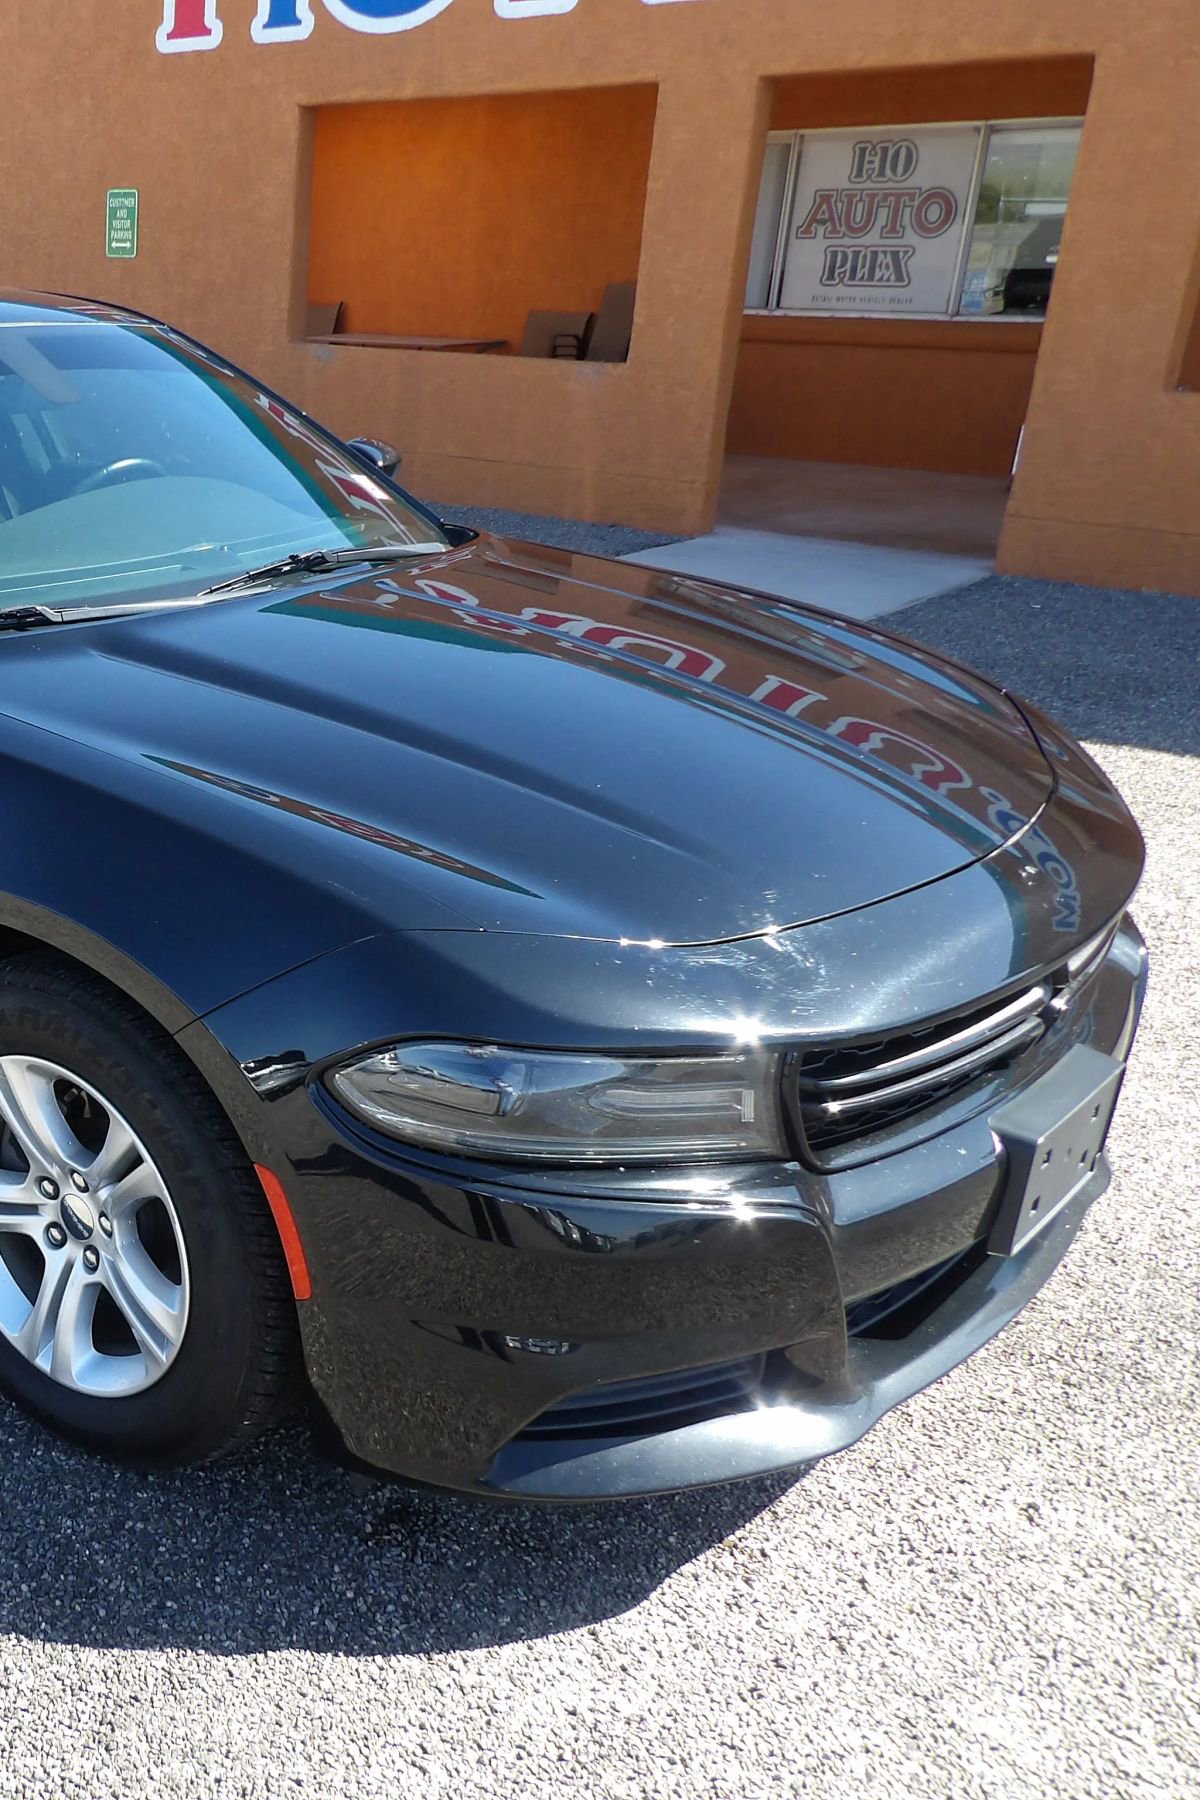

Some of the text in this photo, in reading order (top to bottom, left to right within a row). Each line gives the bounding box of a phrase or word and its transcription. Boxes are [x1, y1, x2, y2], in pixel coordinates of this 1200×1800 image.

[109, 197, 135, 208] CUSTOMER
[116, 208, 128, 218] AND
[796, 187, 957, 239] AUTO
[112, 219, 131, 229] VISITOR
[110, 230, 132, 240] PARKING
[820, 245, 915, 287] PLEX
